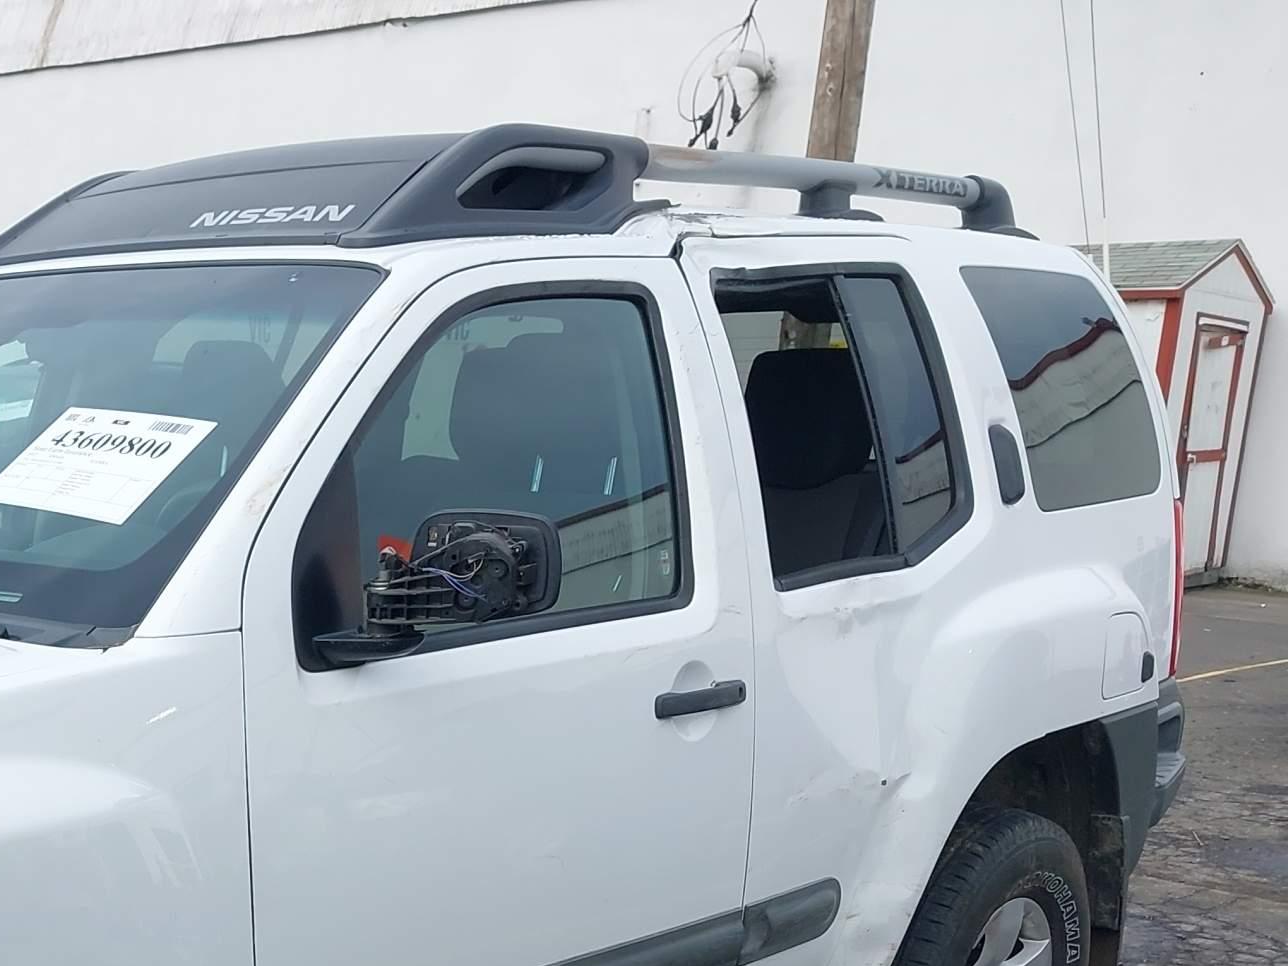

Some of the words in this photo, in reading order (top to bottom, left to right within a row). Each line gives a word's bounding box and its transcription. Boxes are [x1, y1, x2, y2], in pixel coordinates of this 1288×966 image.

[872, 168, 969, 198] XTERRA
[189, 204, 356, 228] NISSAN
[51, 429, 173, 459] 43609800
